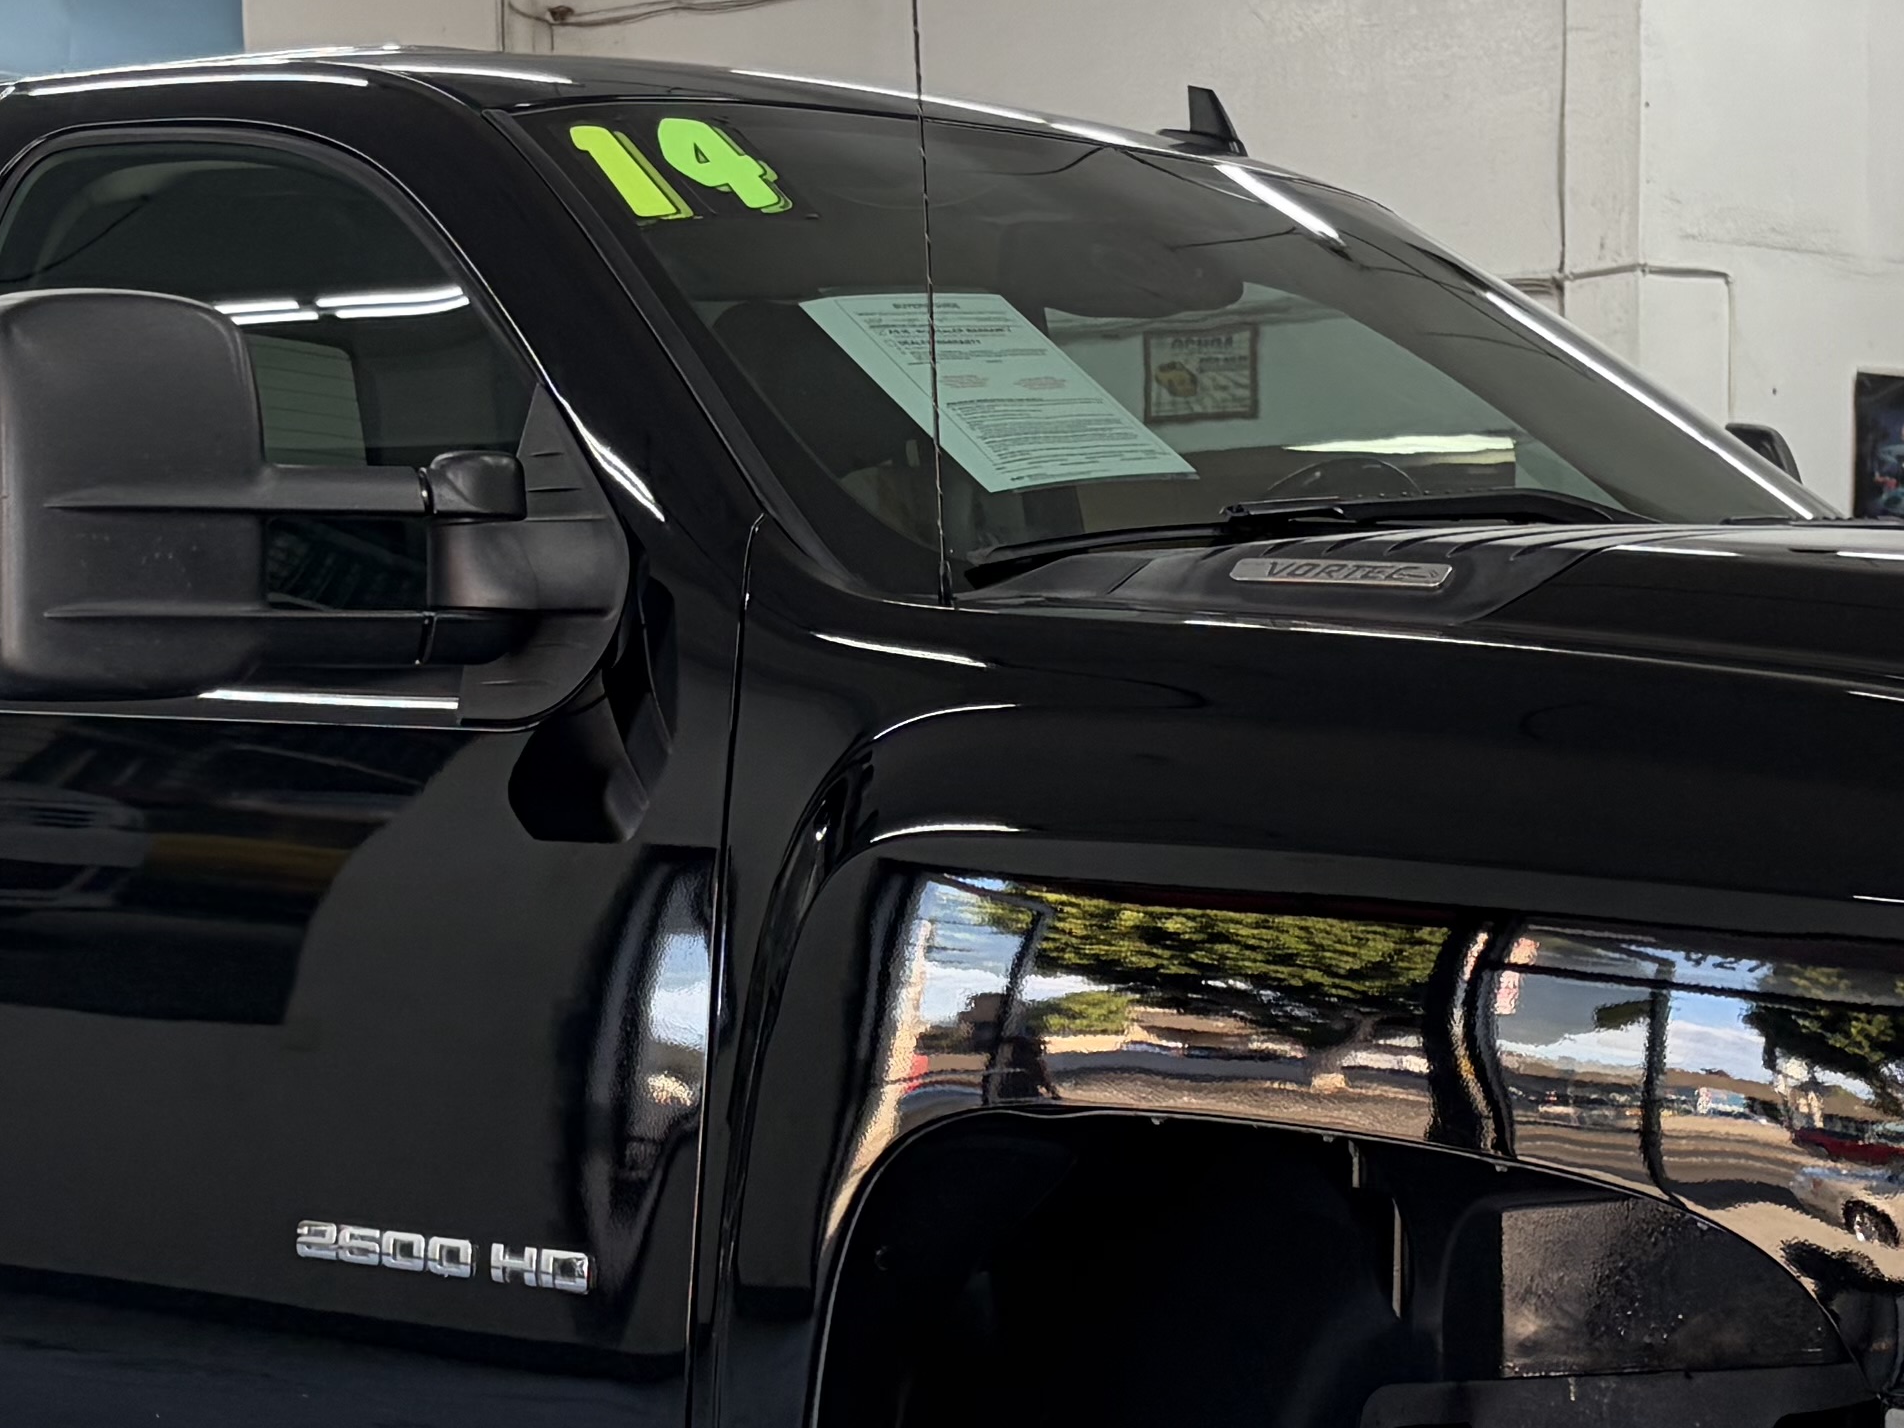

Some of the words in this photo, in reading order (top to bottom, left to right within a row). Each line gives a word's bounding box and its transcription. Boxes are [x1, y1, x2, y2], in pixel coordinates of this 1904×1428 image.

[569, 116, 794, 219] 14
[1267, 560, 1430, 580] VORTEC
[296, 1220, 473, 1278] 2500
[490, 1242, 589, 1294] HD
